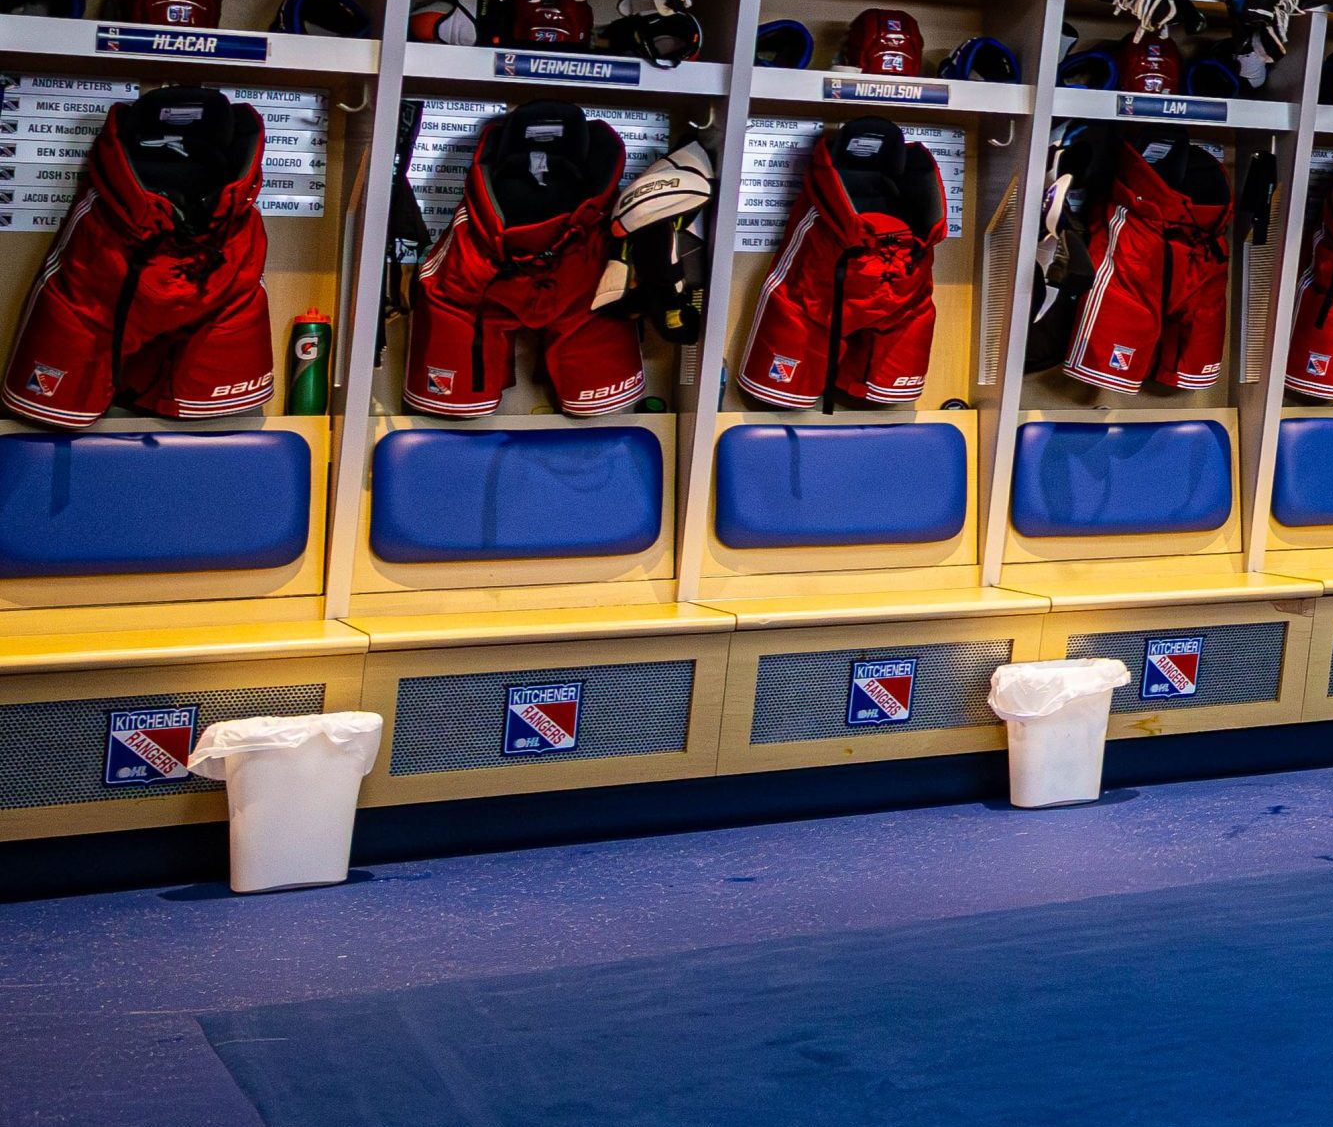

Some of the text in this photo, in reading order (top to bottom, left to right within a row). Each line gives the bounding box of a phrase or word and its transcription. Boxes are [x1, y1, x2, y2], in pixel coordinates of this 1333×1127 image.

[167, 5, 190, 22] 61
[152, 34, 218, 53] HLACAR
[505, 54, 516, 64] 27
[881, 55, 903, 71] 24
[530, 58, 613, 79] VERMEULEN
[32, 77, 132, 93] ANDREW PETERS 9
[235, 90, 264, 100] BOBBY
[266, 91, 301, 102] NAYLOR
[855, 83, 922, 100] NICHOLSON
[36, 101, 107, 114] MIKE GRESDAL
[446, 102, 485, 112] LISABETH
[1162, 101, 1187, 115] LAM
[267, 114, 291, 123] DUFF
[585, 110, 622, 119] BRANDON
[28, 124, 52, 134] ALEX
[441, 123, 477, 132] BENNETT
[776, 121, 798, 130] PAYER
[917, 129, 942, 137] LARTER
[311, 137, 324, 147] 44
[748, 139, 799, 149] RYAN RAMSAY
[37, 147, 56, 157] BEN
[266, 158, 323, 169] DODERO 44
[411, 164, 433, 172] SEAN
[753, 159, 790, 169] PAT DAVIS
[36, 171, 62, 180] JOSH
[261, 179, 294, 189] CARTER
[413, 185, 433, 194] MIKE
[22, 193, 49, 203] JACOB
[744, 198, 763, 207] JOSH
[262, 200, 300, 211] LIPANOV
[33, 216, 57, 226] KYLE
[295, 336, 319, 361] G
[1150, 640, 1199, 655] KITCHENER
[857, 662, 913, 680] KITCHENER
[1156, 654, 1189, 692] RANGERS
[511, 687, 577, 705] KITCHENER
[864, 678, 902, 717] RANGERS
[115, 710, 189, 732] KITCHENER
[520, 703, 567, 746] RANGERS
[124, 730, 178, 775] RANGERS
